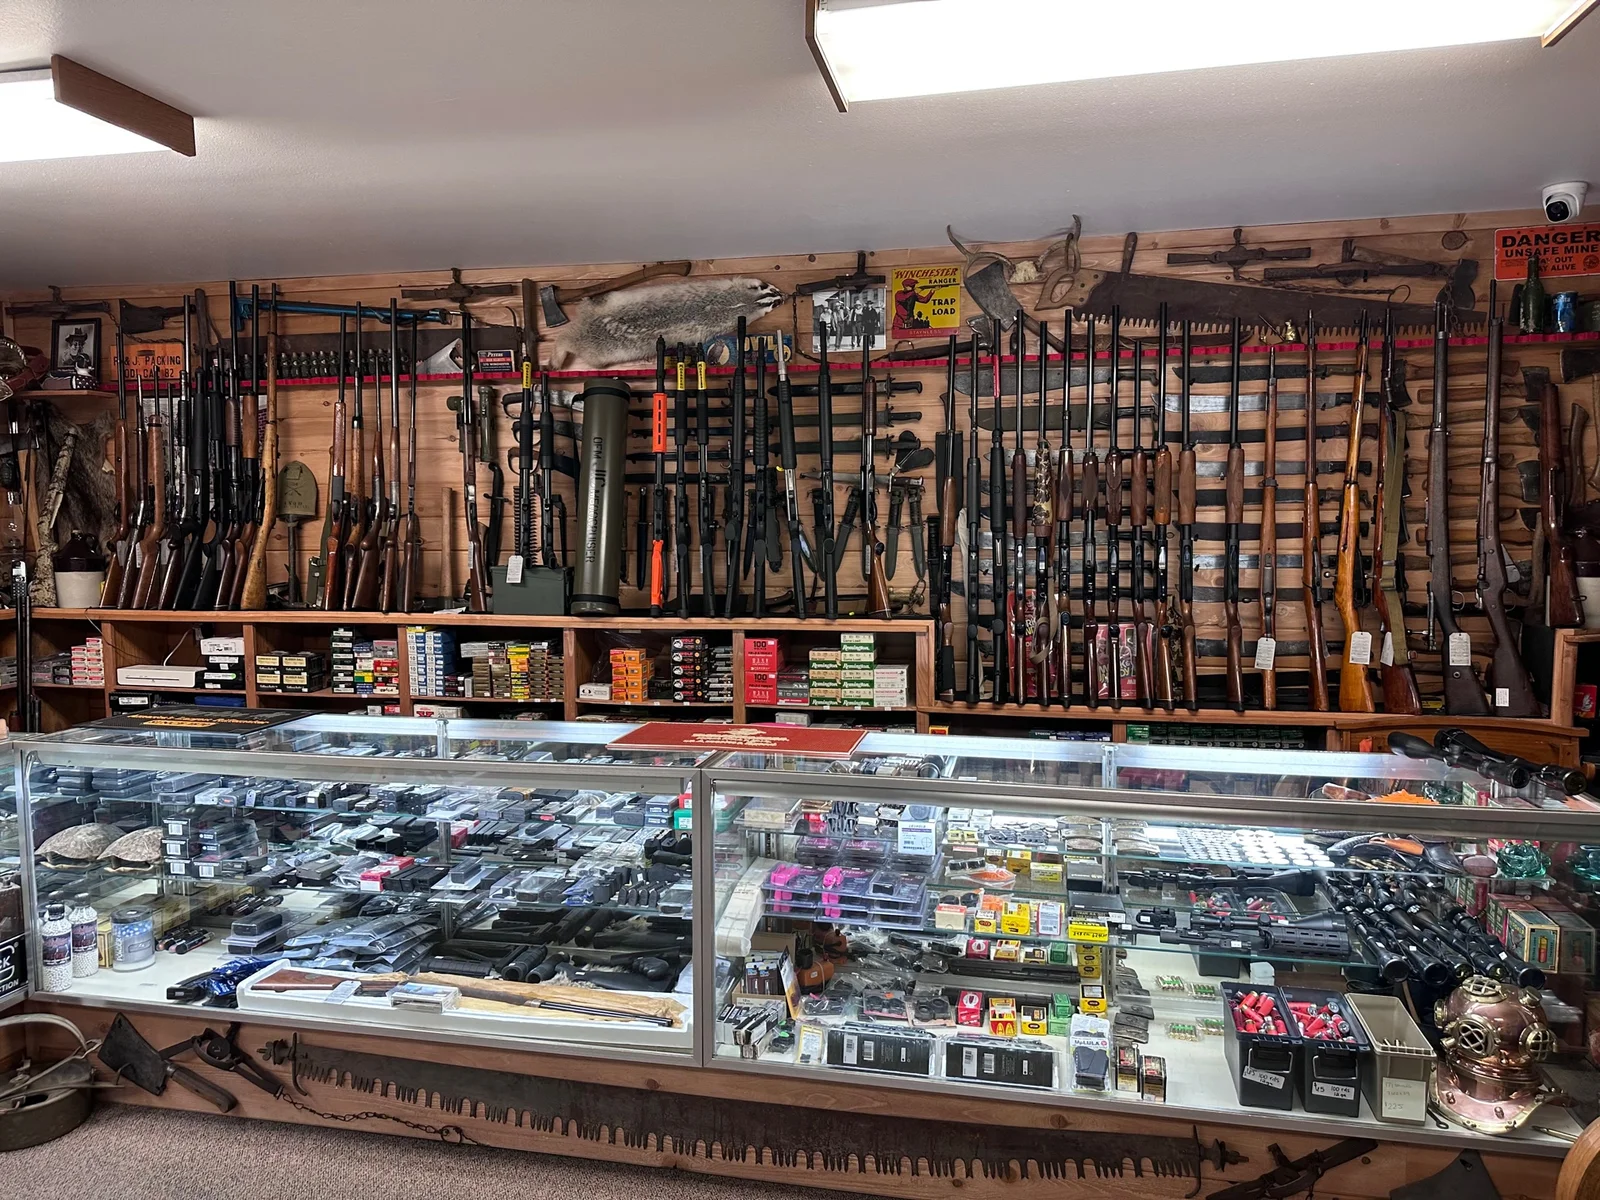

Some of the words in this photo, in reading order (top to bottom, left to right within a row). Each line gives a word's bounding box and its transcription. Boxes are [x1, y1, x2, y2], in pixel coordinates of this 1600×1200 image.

[1502, 230, 1600, 248] DANGER
[1505, 246, 1559, 258] UNSAFE
[895, 267, 958, 279] WINCHESTER
[932, 298, 956, 306] TRAP
[145, 356, 181, 366] PACKING
